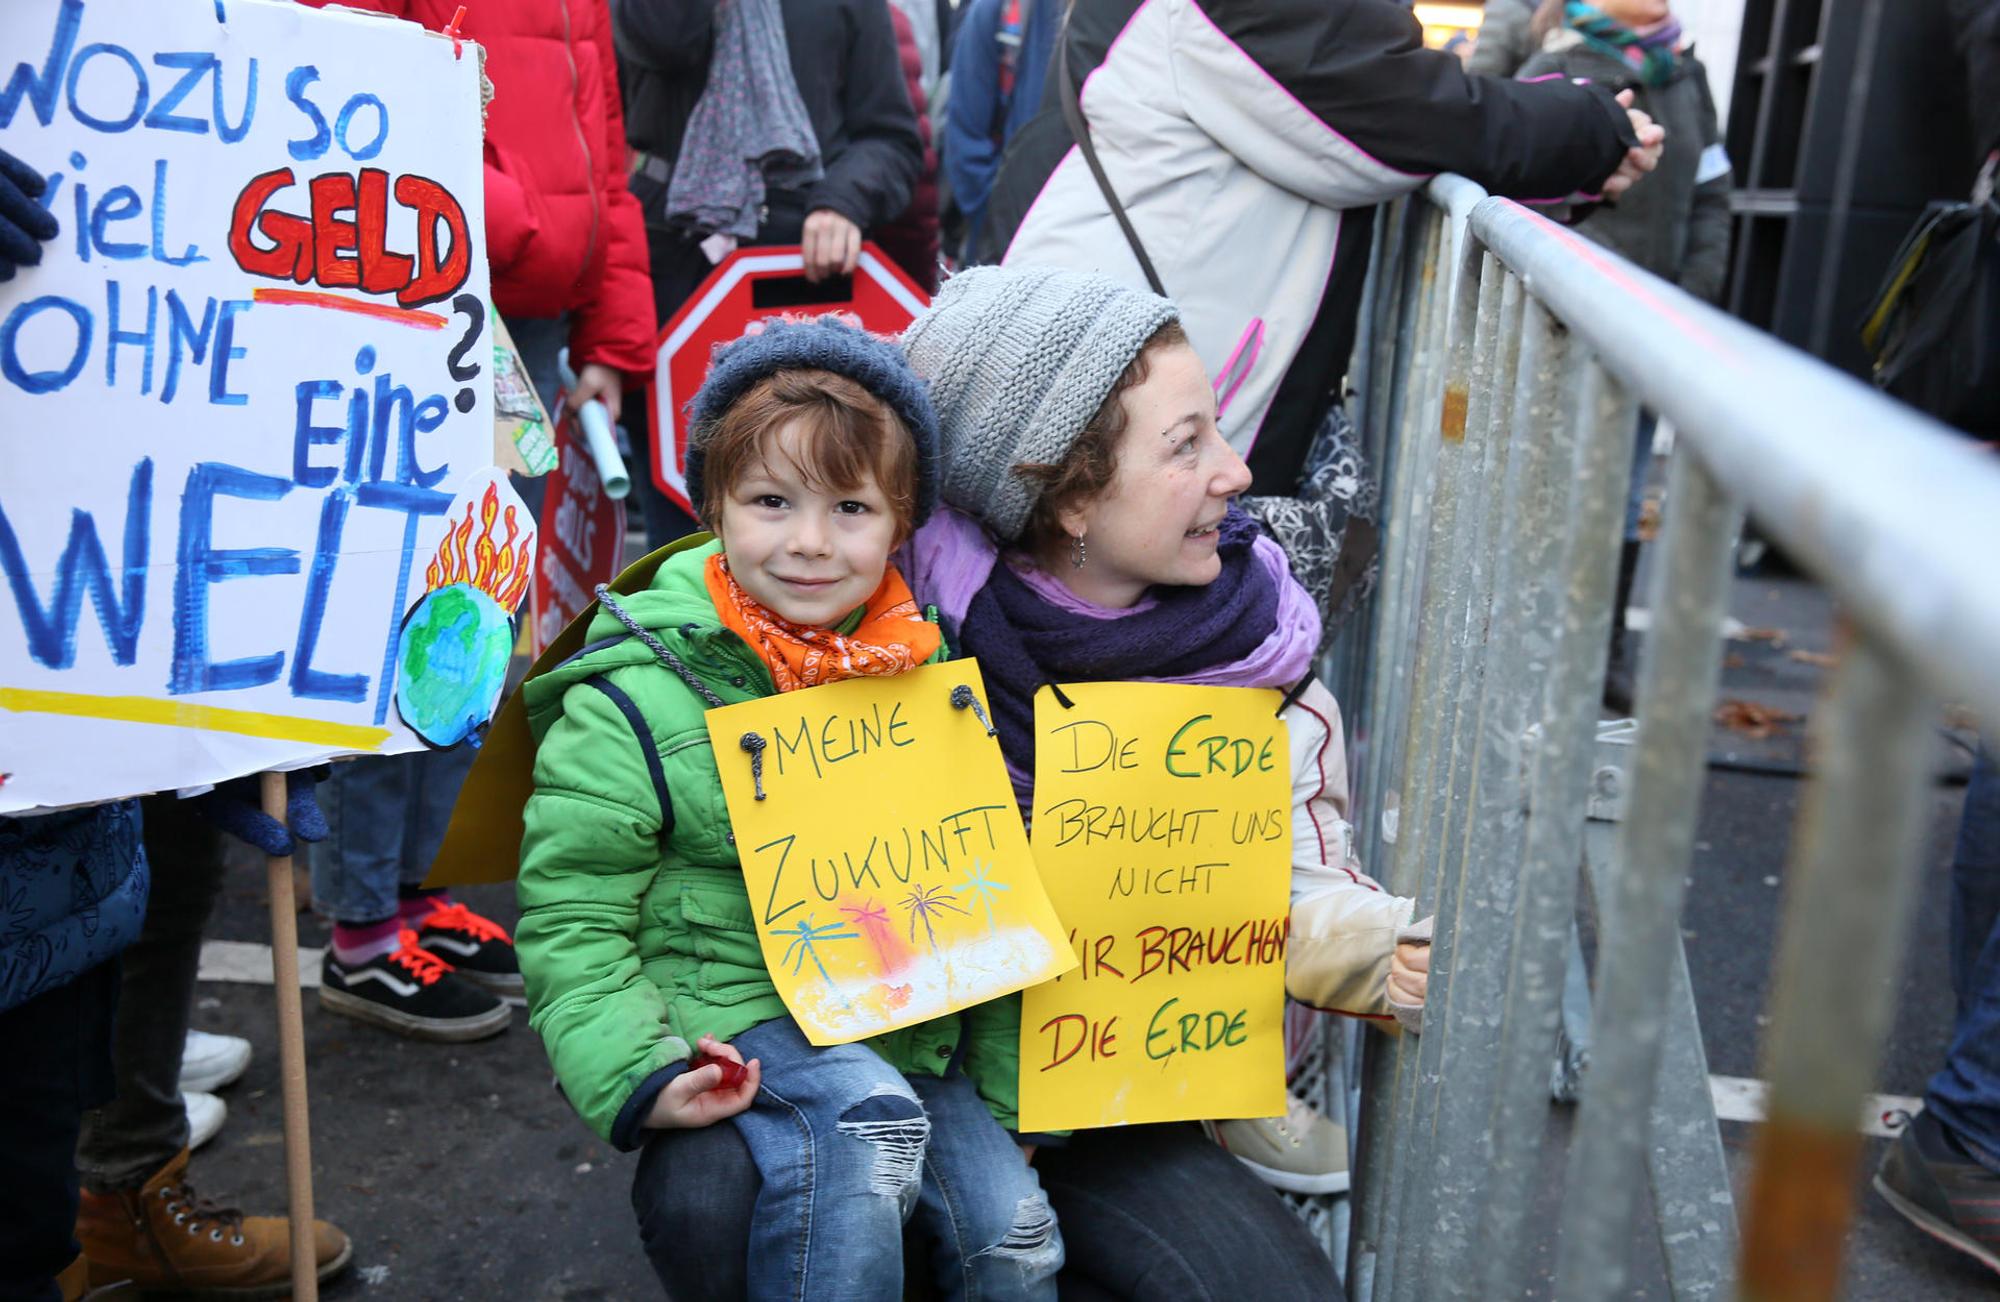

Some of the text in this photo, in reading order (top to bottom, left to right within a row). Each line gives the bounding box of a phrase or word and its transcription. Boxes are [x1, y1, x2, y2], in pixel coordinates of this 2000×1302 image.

[0, 0, 258, 144] WOZU
[228, 167, 472, 309] GELD
[0, 280, 253, 405] OHNE
[447, 293, 485, 414] ?
[0, 455, 456, 726] WELT
[774, 702, 915, 778] MEINE
[1050, 714, 1275, 779] DIE ERDE
[754, 805, 1008, 925] ZUKUNFT
[1044, 798, 1283, 848] BRAUCHT UNS
[1108, 862, 1230, 900] NICHT
[1056, 915, 1290, 984] IR BRAUCHEN
[1039, 997, 1248, 1072] DIE ERDE
